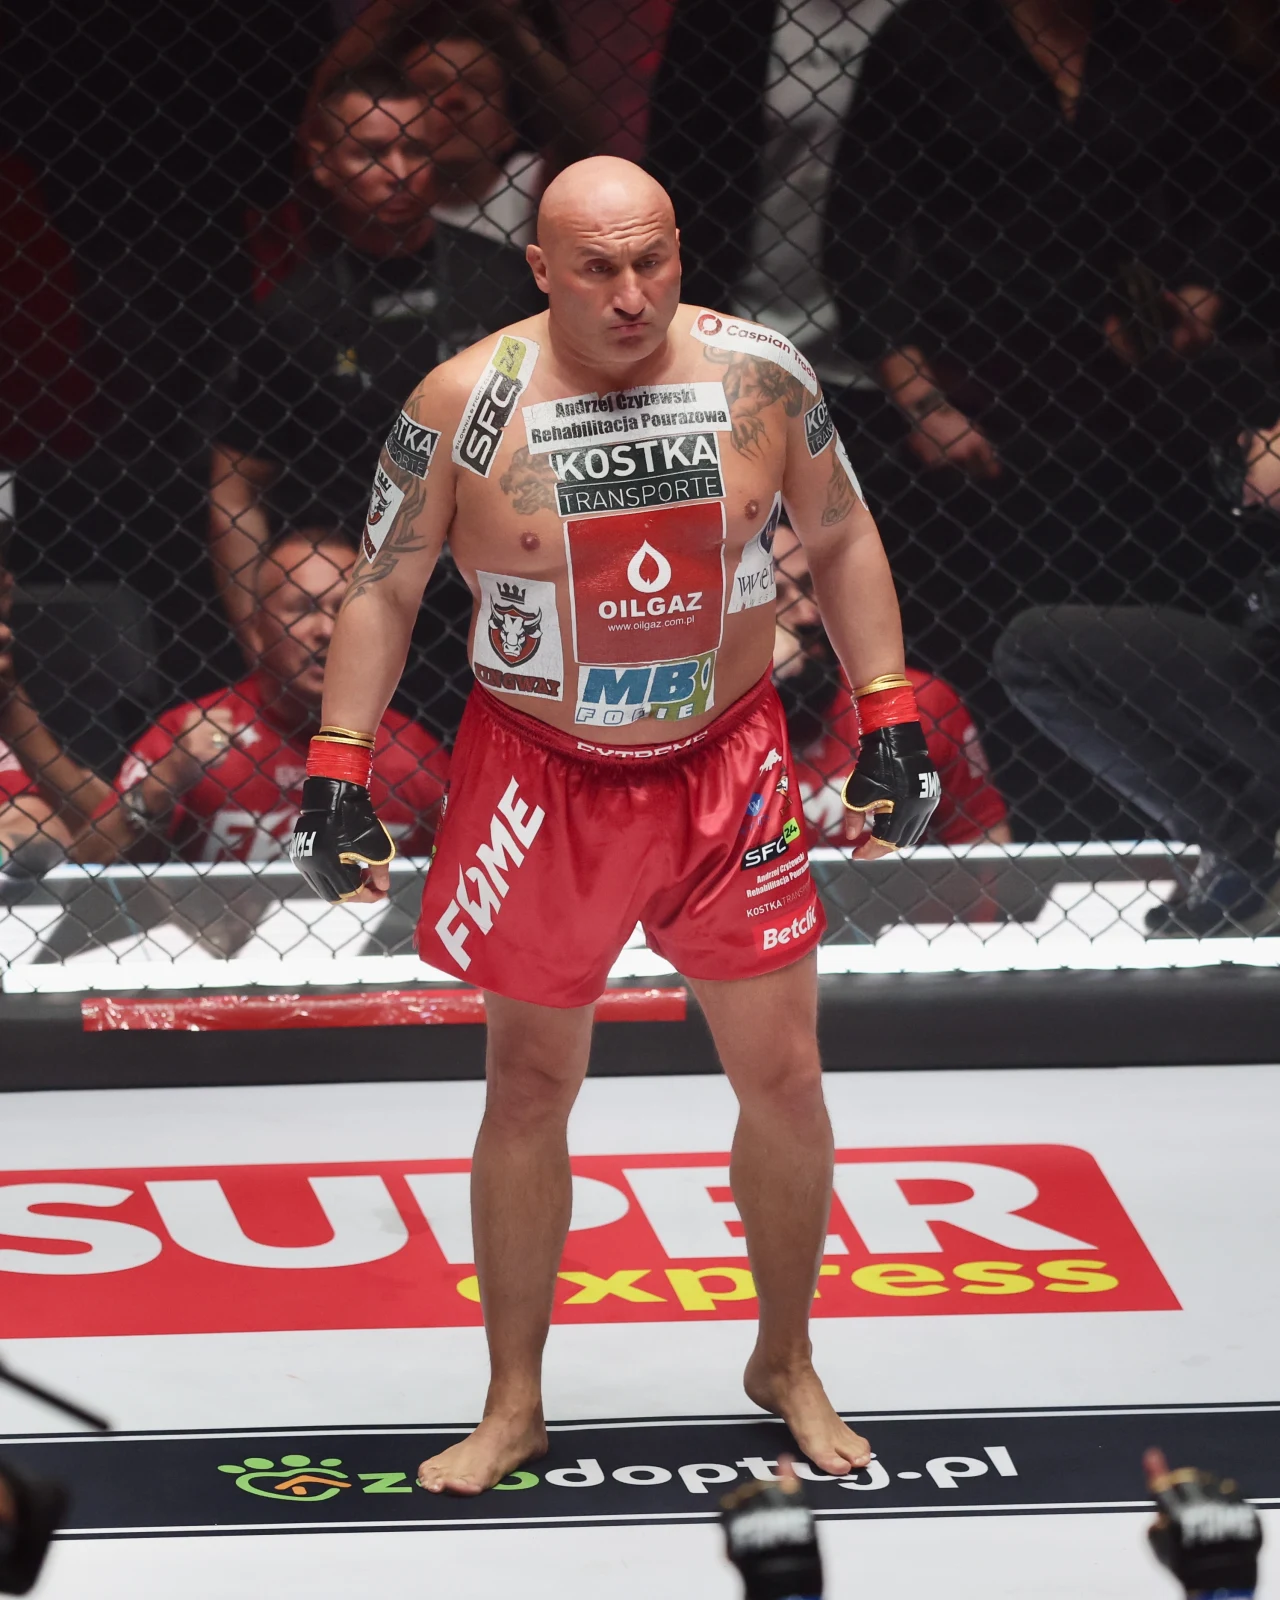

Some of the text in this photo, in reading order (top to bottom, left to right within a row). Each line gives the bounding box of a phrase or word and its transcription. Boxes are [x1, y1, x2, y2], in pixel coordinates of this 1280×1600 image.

[727, 325, 790, 354] Caspian
[555, 388, 697, 418] Andrzej Czyżewski
[466, 375, 516, 465] SFC
[531, 410, 727, 444] Rehabilitacja Pourazowa
[556, 436, 718, 482] KOSTKA
[561, 476, 720, 513] TRANSPORTE
[598, 592, 703, 619] OILGAZ
[608, 615, 695, 632] www.oilgaz.com.pl
[745, 836, 787, 867] SFC
[784, 824, 798, 838] 24
[434, 774, 546, 972] FAME
[746, 875, 790, 898] Rehabilitacja
[757, 866, 780, 884] Andrzej
[746, 900, 782, 918] KOSTKA
[357, 1445, 1019, 1495] zodoptuj.pl
